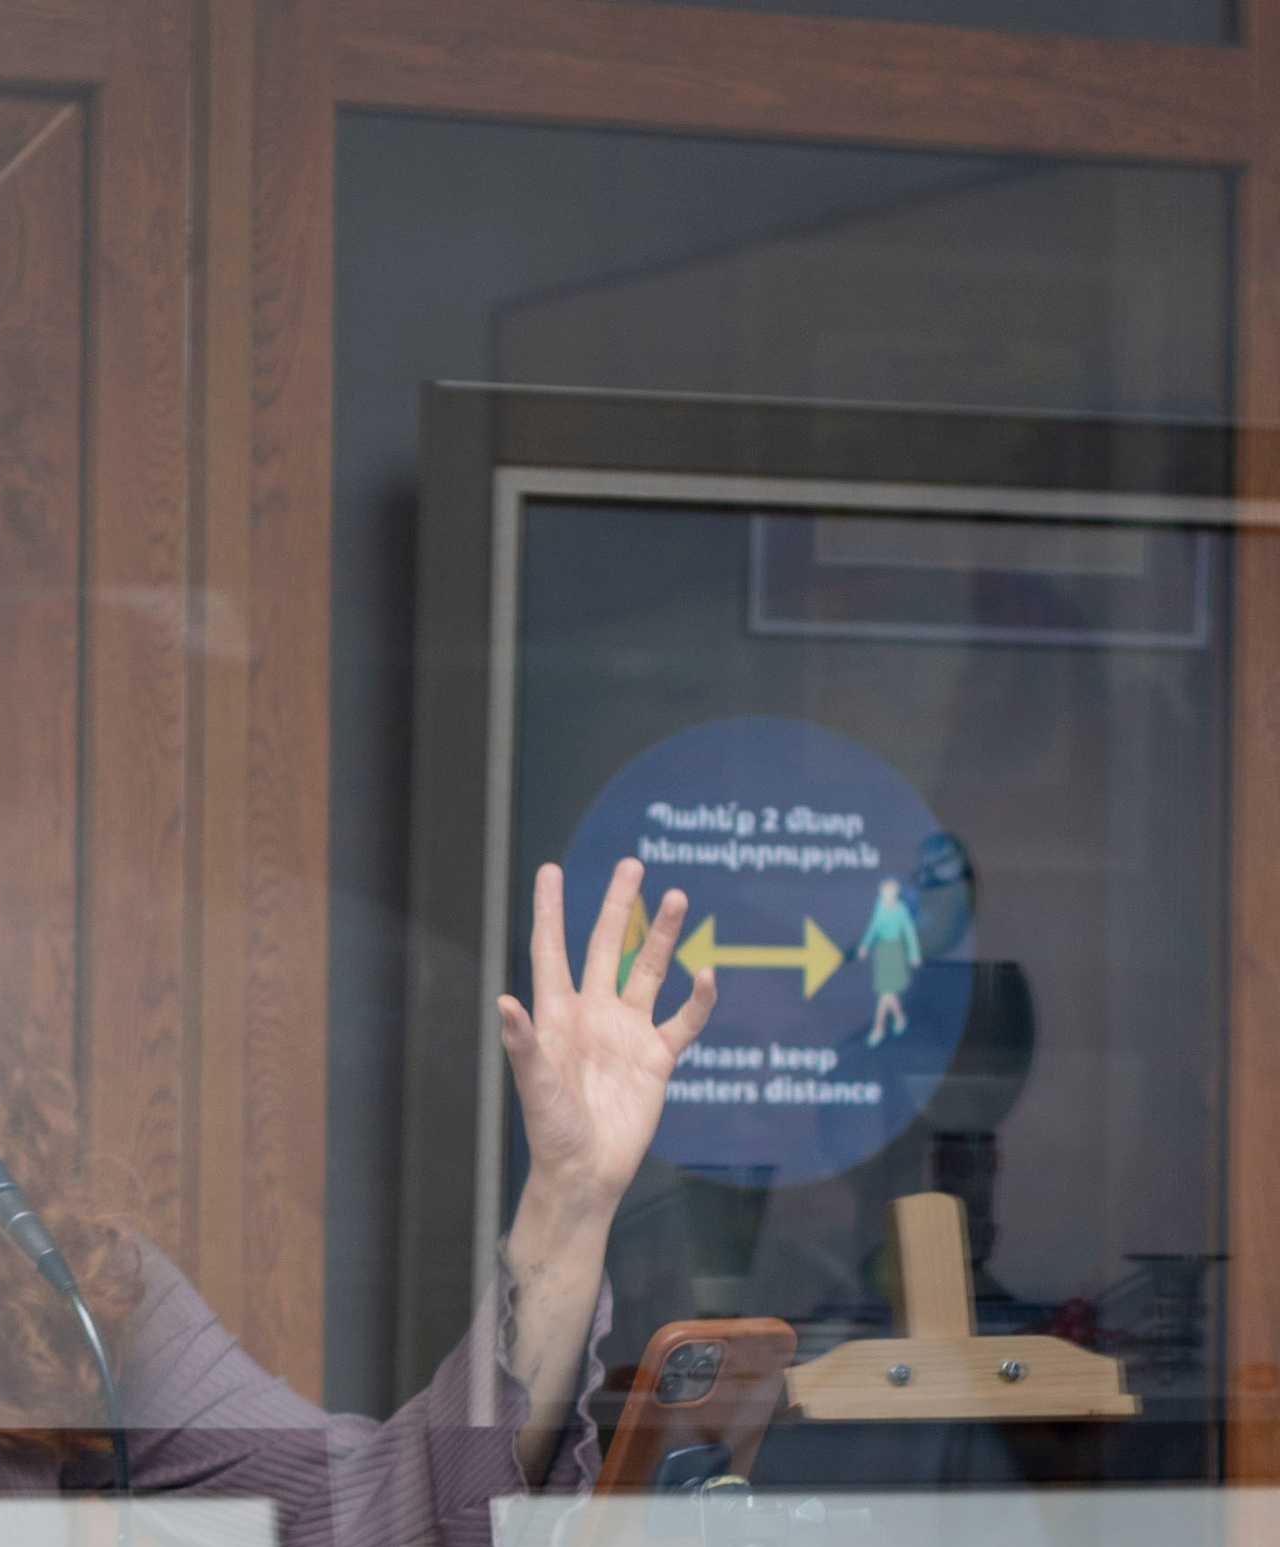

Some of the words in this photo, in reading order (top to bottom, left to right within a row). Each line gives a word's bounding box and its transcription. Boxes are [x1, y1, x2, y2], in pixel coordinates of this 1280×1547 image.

[761, 806, 779, 833] 2
[771, 1042, 838, 1076] keep
[666, 1078, 758, 1103] meters
[765, 1075, 882, 1104] distance
